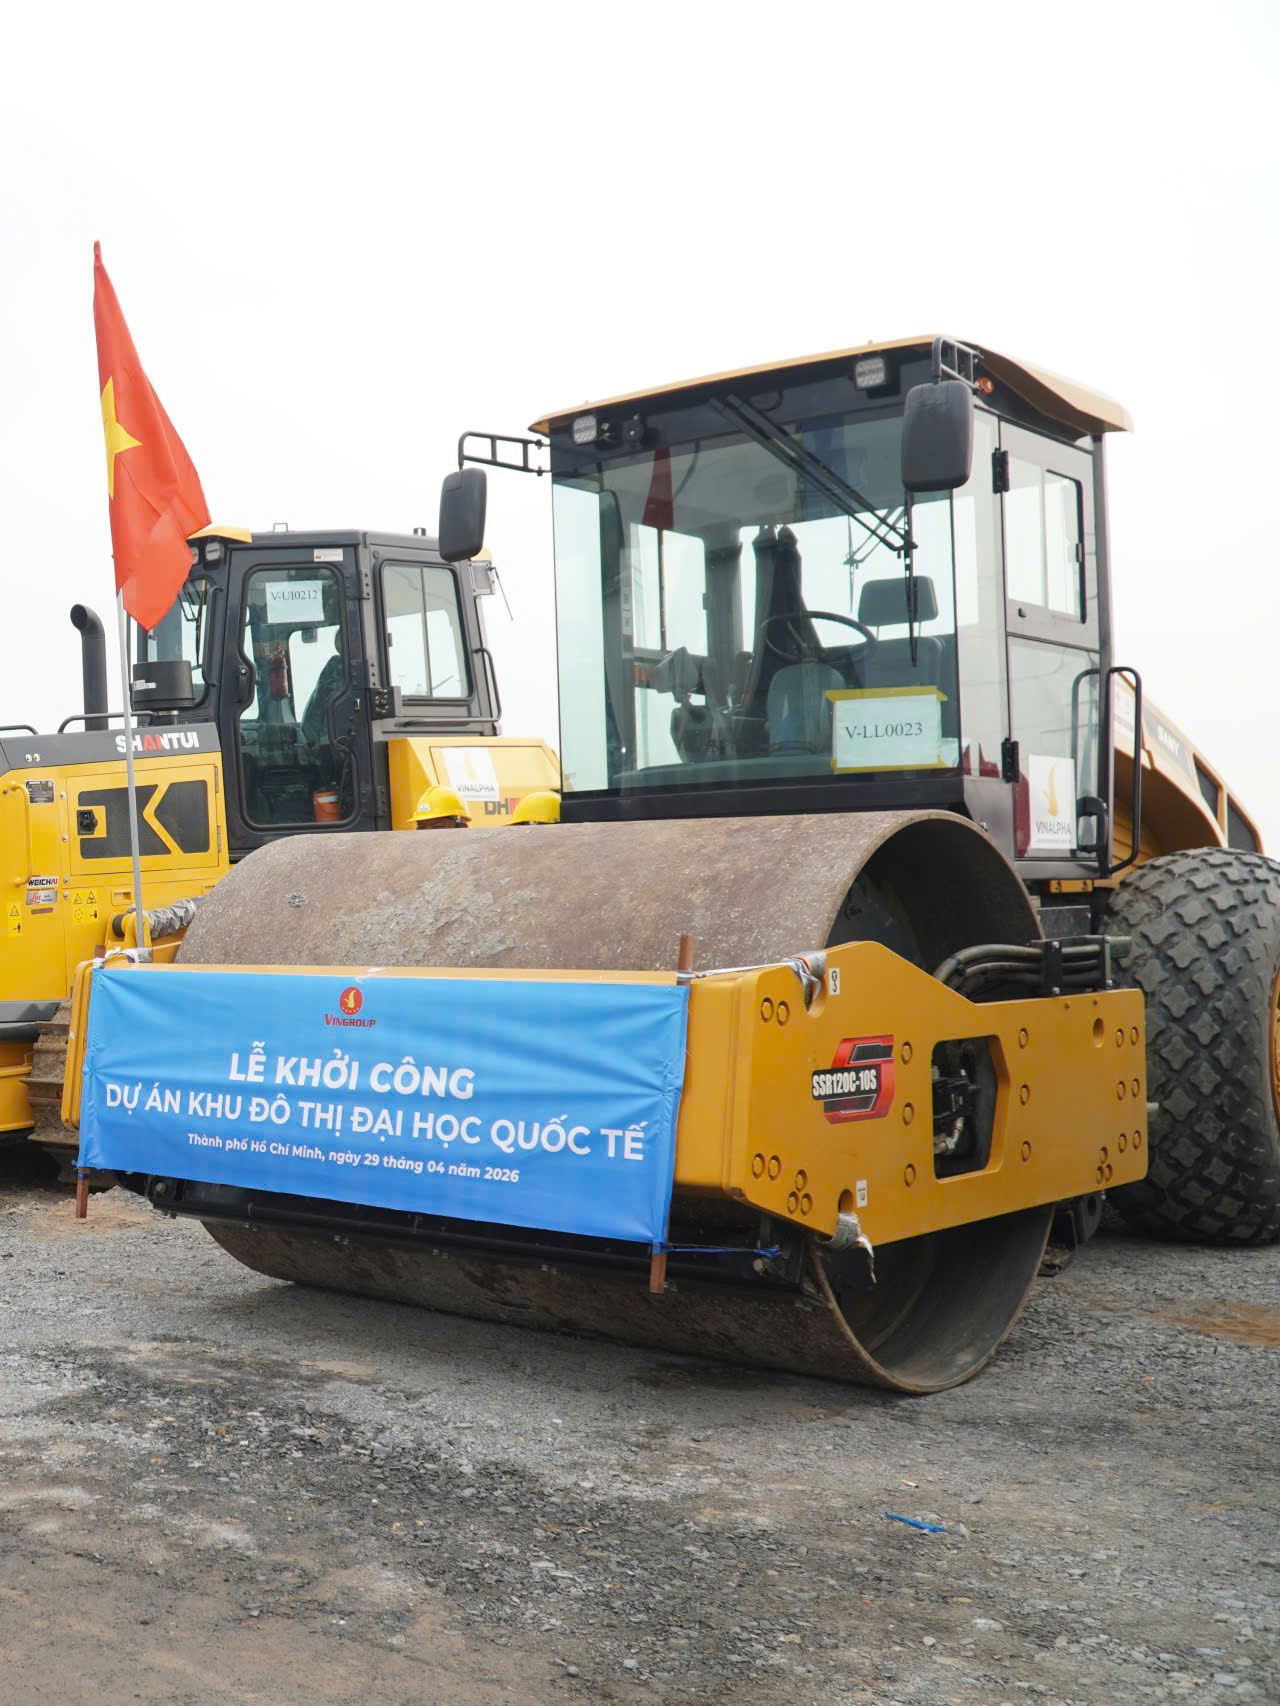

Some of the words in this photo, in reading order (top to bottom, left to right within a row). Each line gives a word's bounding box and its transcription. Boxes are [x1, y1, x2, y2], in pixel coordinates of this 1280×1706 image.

[845, 722, 923, 739] V-LL0023
[115, 732, 200, 753] SHANTUI
[456, 784, 495, 793] VINALPHA
[1036, 821, 1072, 835] VINALPHA
[28, 878, 58, 887] WEICHAI
[324, 1013, 376, 1028] VINGROUP
[228, 1041, 266, 1083] LỄ
[275, 1049, 359, 1090] KHỞI
[370, 1056, 475, 1099] CÔNG
[812, 1069, 877, 1096] SSR120C-10S
[106, 1083, 142, 1115] DỰ
[144, 1082, 181, 1114] ÁN
[188, 1091, 242, 1120] KHU
[249, 1093, 291, 1125] ĐÔ
[298, 1101, 343, 1136] THỊ
[350, 1106, 403, 1141] ĐẠI
[412, 1111, 482, 1148] HỌC
[490, 1114, 592, 1154] QUỐC
[600, 1121, 649, 1161] TẾ
[187, 1133, 223, 1148] Thành
[225, 1138, 248, 1153] phố
[250, 1140, 267, 1153] Hồ
[270, 1142, 289, 1156] Chí
[292, 1145, 325, 1163] Minh,
[328, 1151, 361, 1168] ngày
[363, 1153, 380, 1167] 29
[382, 1155, 423, 1174] tháng
[427, 1160, 446, 1175] 04
[448, 1163, 481, 1179] năm
[484, 1167, 520, 1183] 2026
